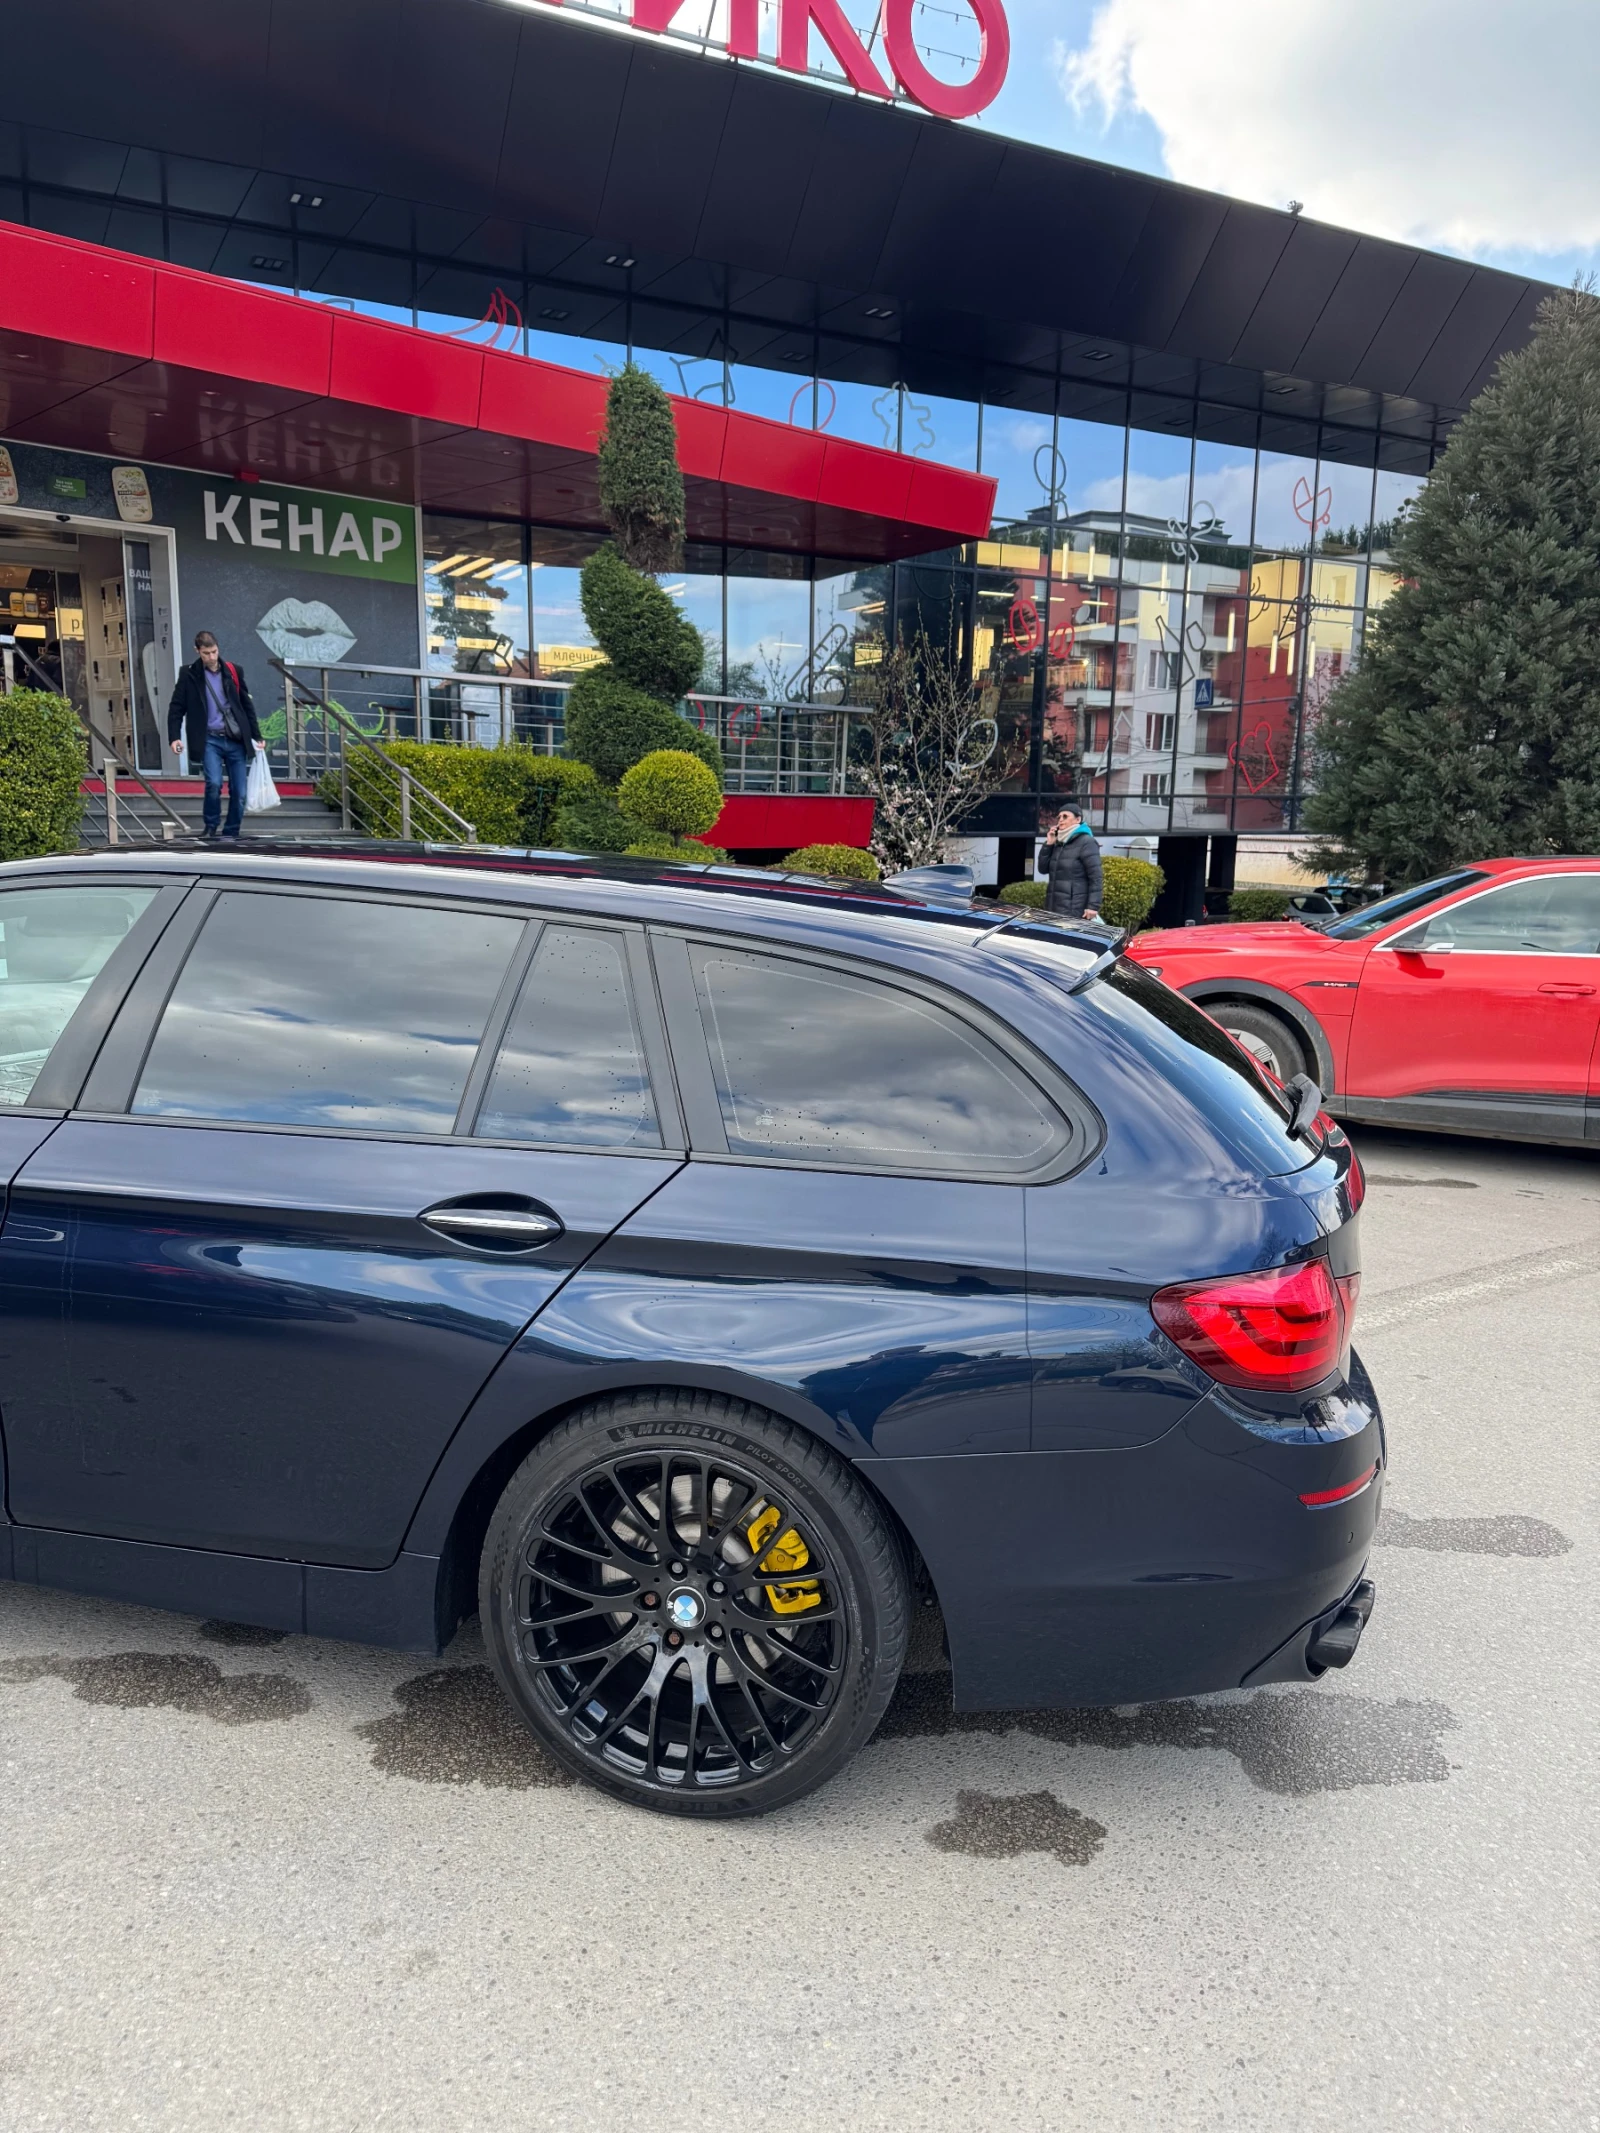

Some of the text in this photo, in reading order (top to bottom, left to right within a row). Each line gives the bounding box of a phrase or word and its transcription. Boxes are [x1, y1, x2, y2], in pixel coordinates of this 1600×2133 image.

[203, 490, 402, 563] КЕНАР
[637, 1423, 738, 1446] MICHELIN
[745, 1444, 776, 1463] PILOT
[775, 1463, 808, 1489] SPORT
